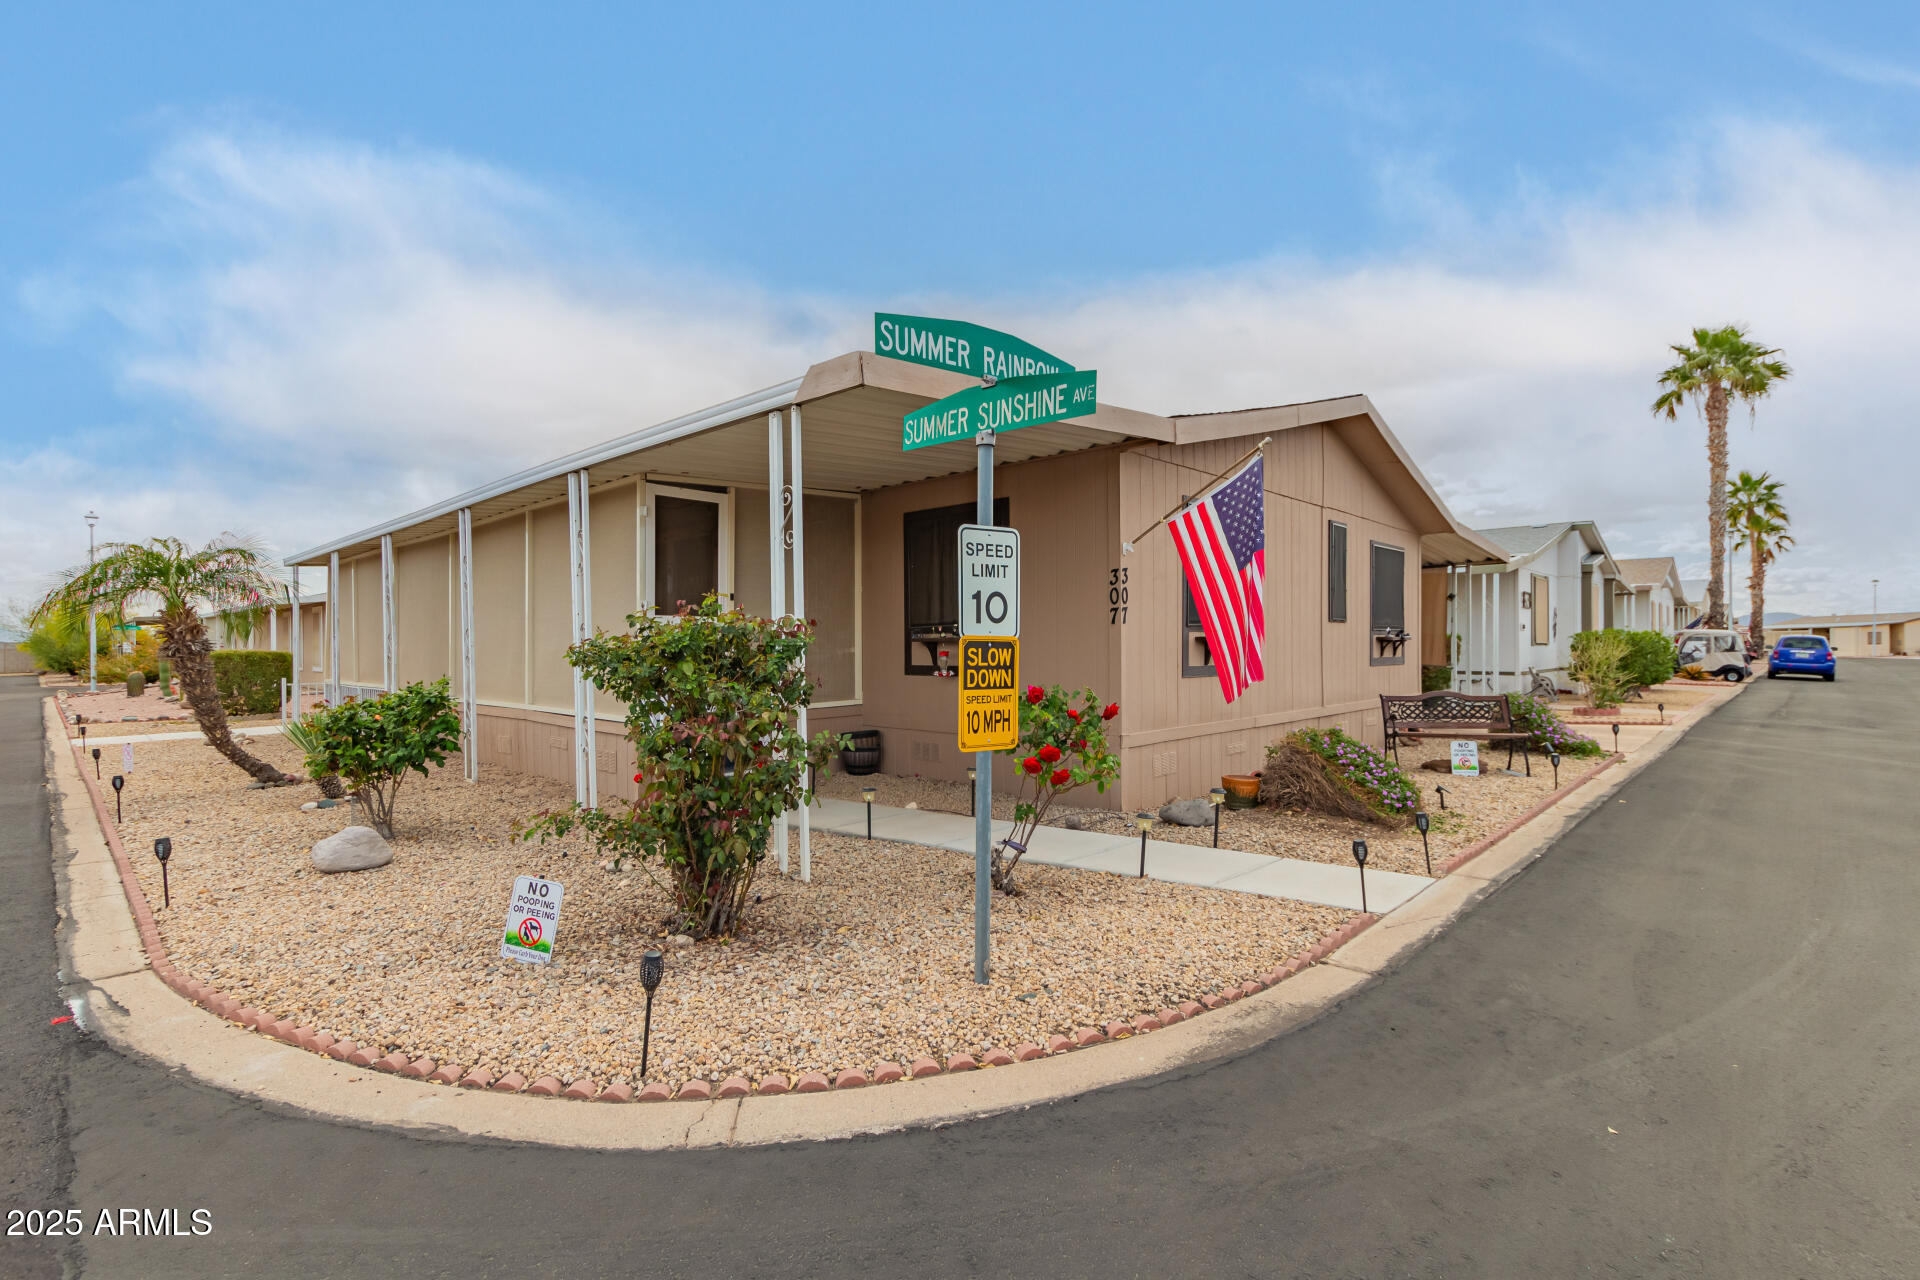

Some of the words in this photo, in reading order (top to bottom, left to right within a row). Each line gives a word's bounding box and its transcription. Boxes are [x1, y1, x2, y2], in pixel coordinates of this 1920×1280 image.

[880, 320, 970, 369] SUMMER
[904, 407, 969, 445] SUMMER
[977, 383, 1067, 430] SUNSHINE
[1072, 384, 1095, 404] AVE
[965, 541, 1014, 559] SPEED
[971, 563, 1009, 579] LIMIT
[971, 589, 1008, 624] 10
[967, 647, 1012, 667] SLOW
[966, 668, 1012, 688] DOWN
[965, 695, 992, 705] SPEED
[993, 694, 1013, 704] LIMIT
[966, 710, 980, 735] 10
[983, 708, 1011, 733] MPH
[527, 881, 549, 898] NO
[517, 894, 555, 910] POOPING
[513, 904, 525, 914] OR
[526, 907, 556, 921] PEEING
